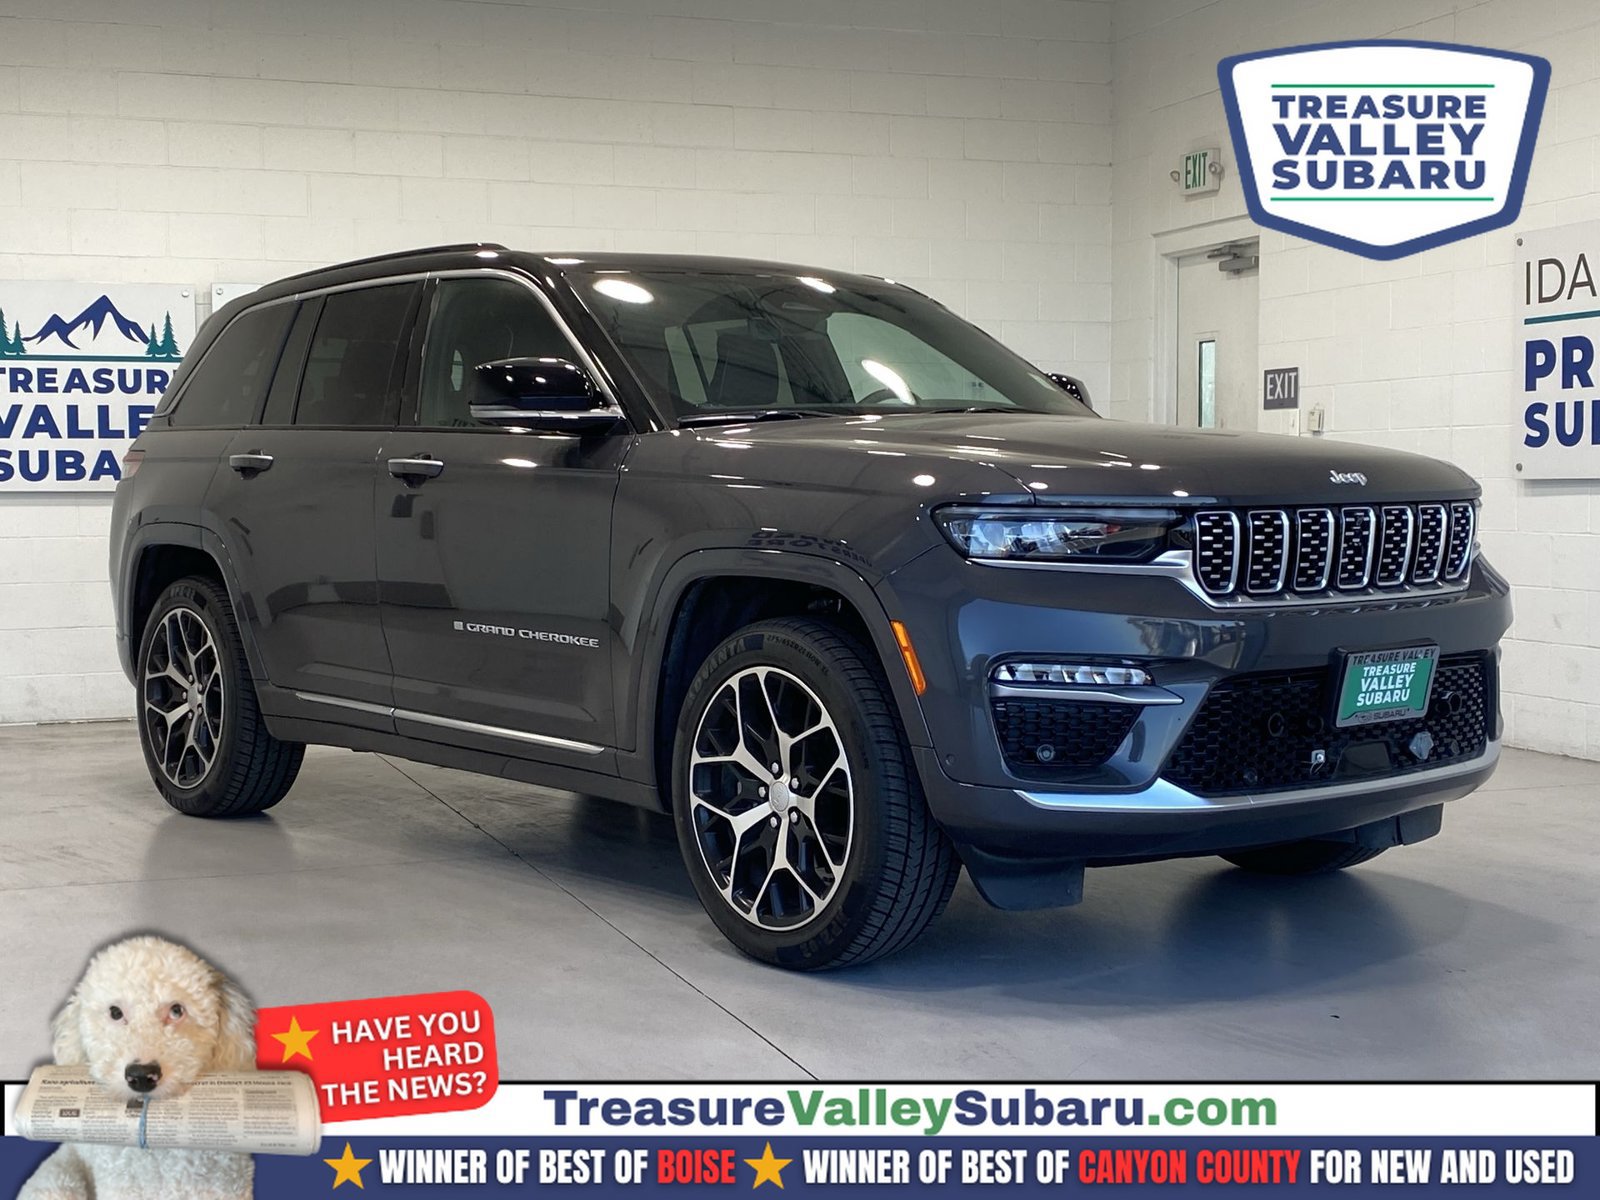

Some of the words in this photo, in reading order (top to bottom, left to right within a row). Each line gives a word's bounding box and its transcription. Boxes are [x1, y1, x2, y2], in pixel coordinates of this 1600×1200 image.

[1185, 152, 1208, 190] EXIT
[1526, 253, 1598, 305] IDA
[0, 367, 177, 394] REASUR
[1266, 372, 1297, 400] EXIT
[1330, 469, 1368, 486] Jeep
[466, 622, 515, 637] GRAND
[518, 629, 599, 648] CHEROKEE
[1353, 652, 1400, 665] TREASURE
[1363, 662, 1417, 677] TREASURE
[1361, 674, 1414, 692] VALLEY
[1356, 689, 1411, 707] SUBARU
[1373, 709, 1407, 719] SUBARU
